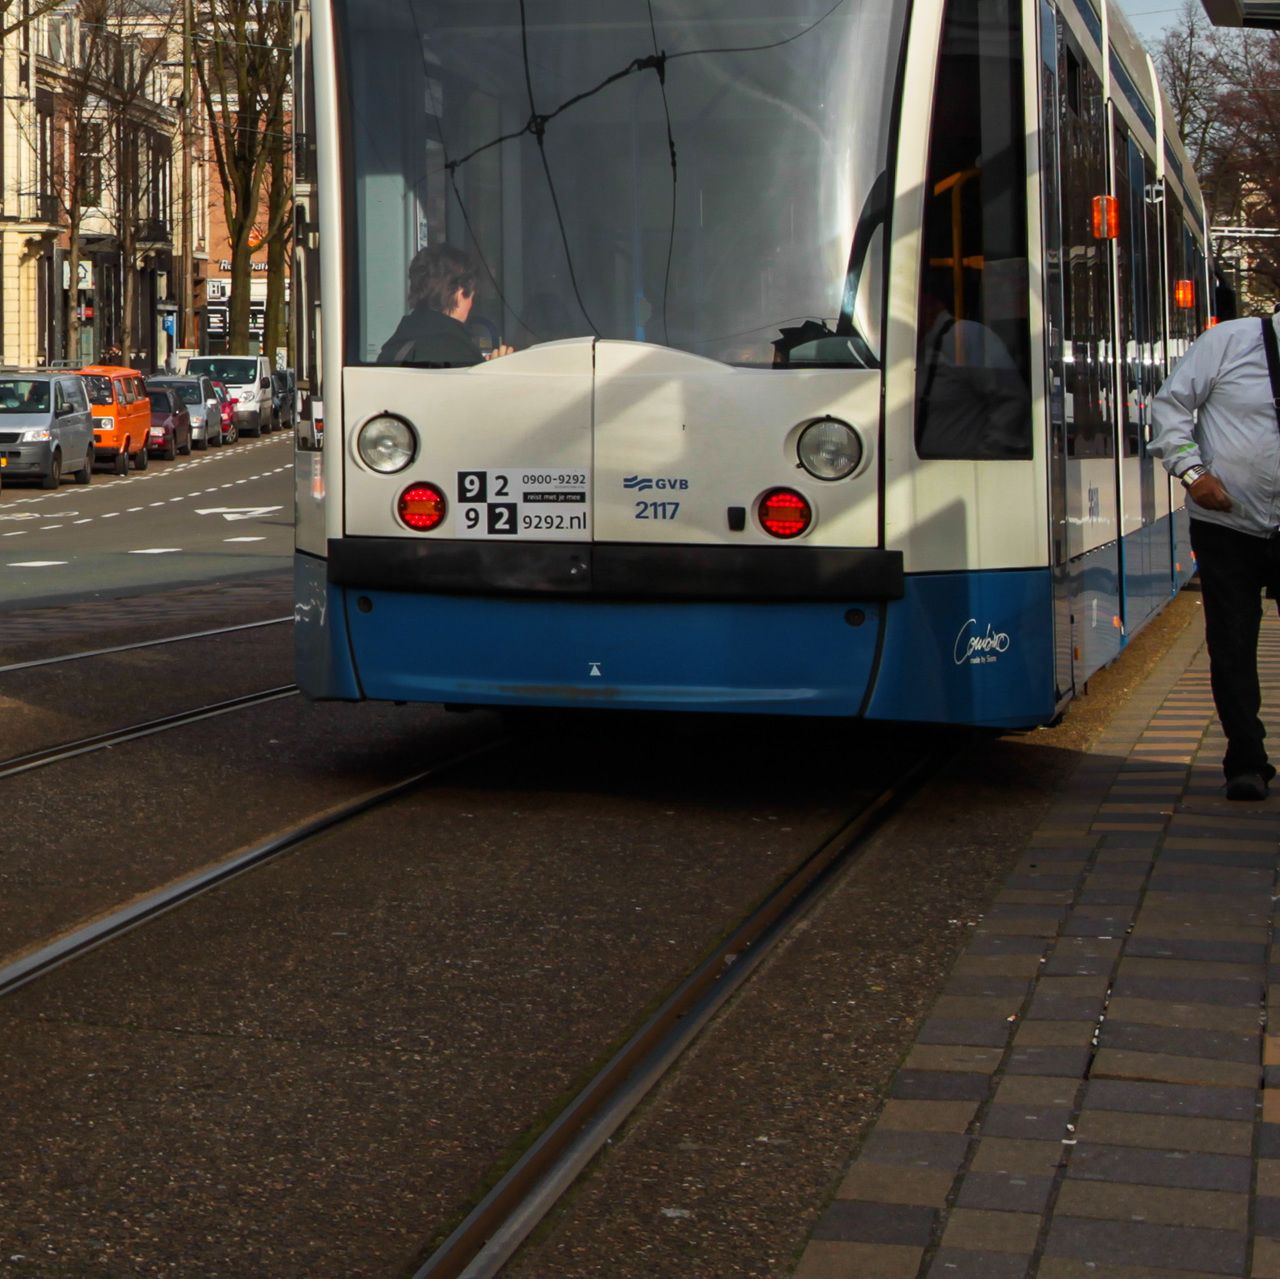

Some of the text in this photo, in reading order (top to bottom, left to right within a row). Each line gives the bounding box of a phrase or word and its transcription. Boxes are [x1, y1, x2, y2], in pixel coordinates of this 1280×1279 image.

[523, 474, 587, 485] 0900-9292
[655, 478, 689, 490] GVB
[635, 501, 681, 520] 2117
[523, 512, 587, 530] 9292.nl
